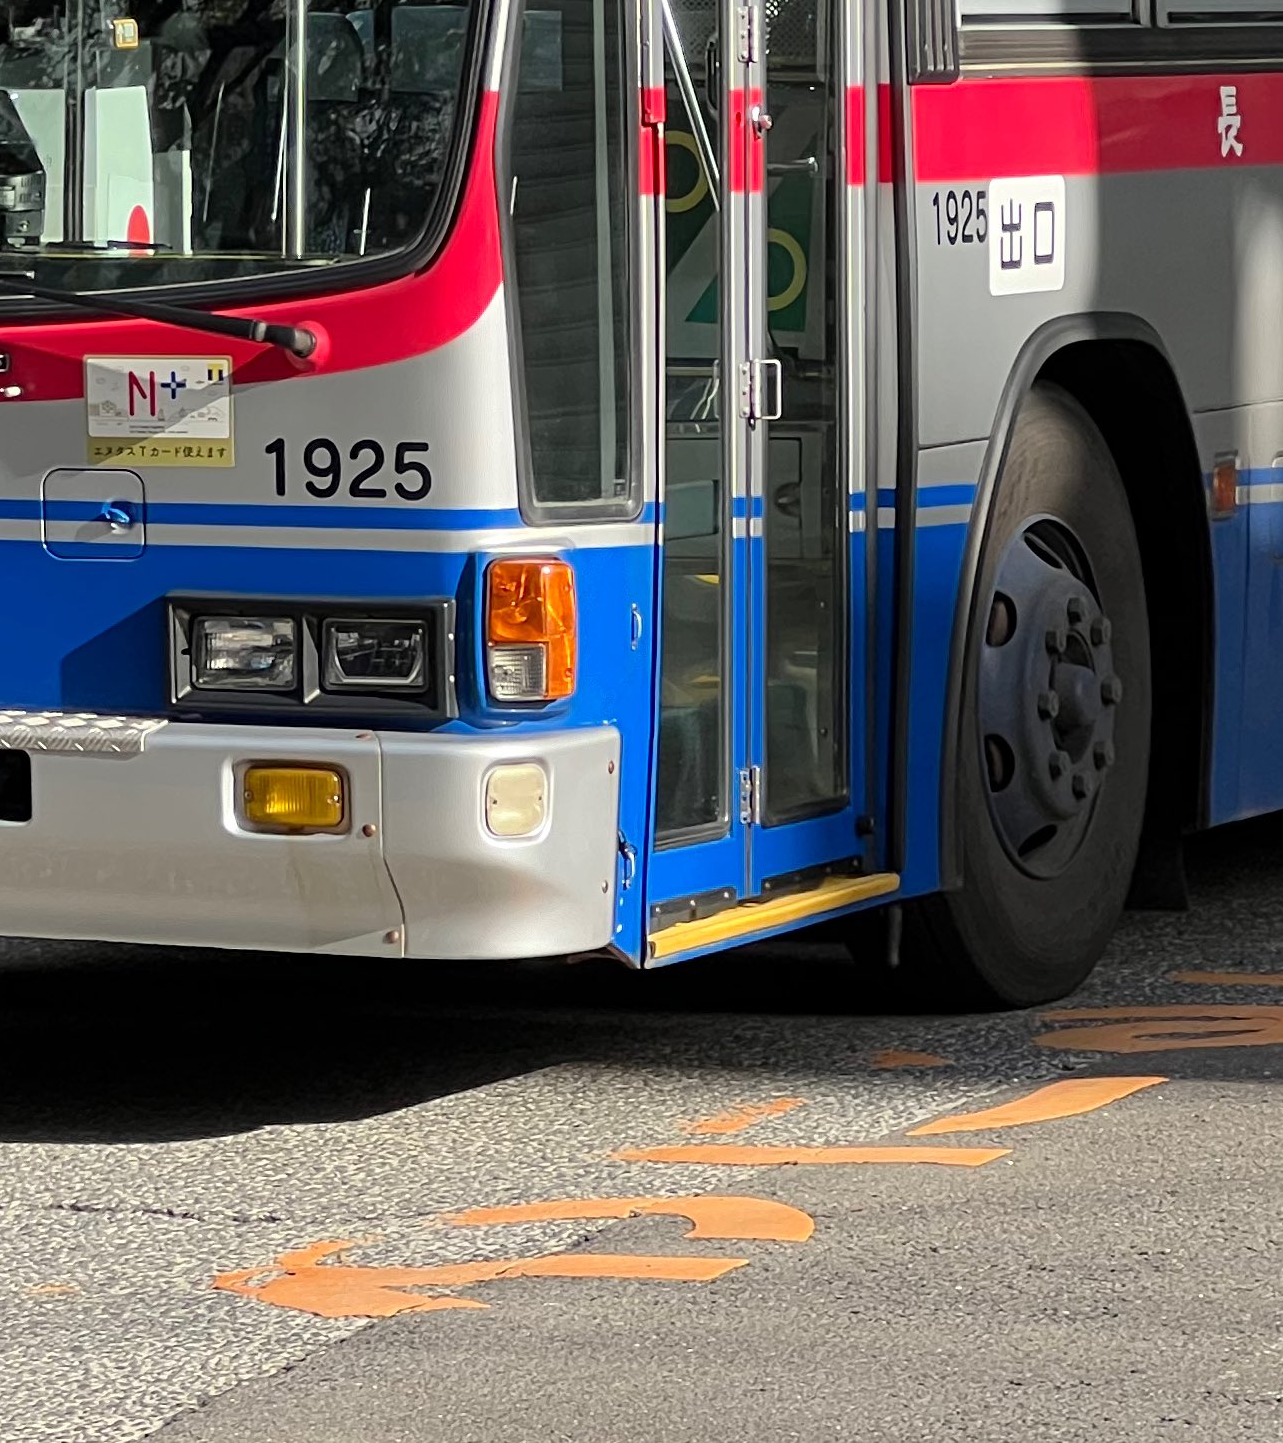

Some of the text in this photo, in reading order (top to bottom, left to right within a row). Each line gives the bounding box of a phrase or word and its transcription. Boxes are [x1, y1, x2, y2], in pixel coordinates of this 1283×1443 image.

[933, 189, 987, 245] 1925
[999, 198, 1056, 269] 出口
[264, 437, 433, 501] 1925
